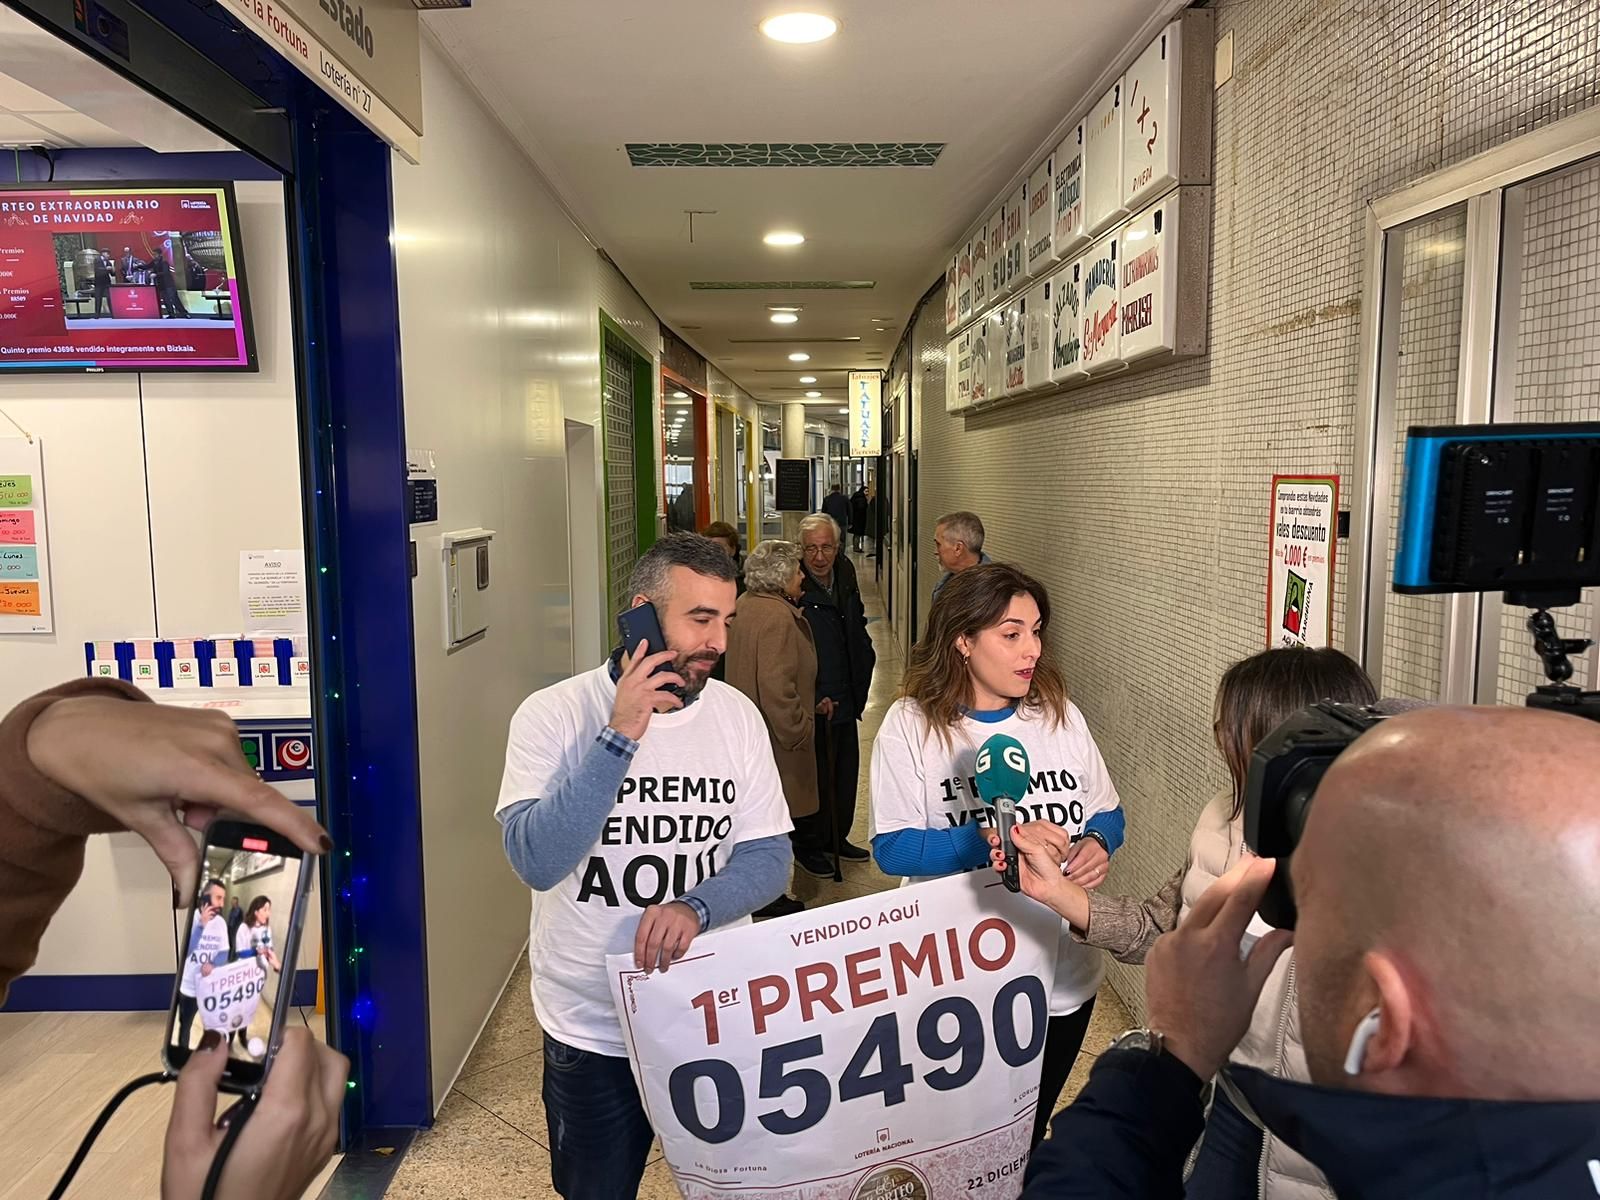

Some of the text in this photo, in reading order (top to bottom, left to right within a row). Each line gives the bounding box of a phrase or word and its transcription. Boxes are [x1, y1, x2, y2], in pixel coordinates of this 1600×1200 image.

[267, 5, 309, 59] Fortuna
[320, 50, 352, 97] Lotería
[362, 89, 372, 114] 27
[1161, 35, 1166, 60] 1
[1114, 84, 1120, 108] 2
[1077, 124, 1082, 145] 3
[33, 212, 115, 223] DE NAVIDAD
[40, 199, 160, 211] EXTRAORDINARIO
[993, 241, 1021, 291] SUSA
[26, 346, 52, 355] premio
[75, 345, 105, 353] vendido
[166, 344, 196, 352] Bizkaia.
[1308, 491, 1329, 503] Navidades
[1291, 516, 1326, 542] descuento
[1284, 543, 1308, 568] 2.000 €
[975, 746, 1026, 774] G G
[616, 776, 736, 804] PREMIO
[601, 814, 732, 845] ENDIDO
[790, 900, 921, 948] VENDIDO AQUÍ
[690, 917, 1017, 1046] 1er PREMIO
[668, 974, 1049, 1145] 05490
[854, 1137, 915, 1160] LOTERÍA NACIONAL
[733, 1165, 768, 1173] Fortuna
[967, 1176, 984, 1191] 22
